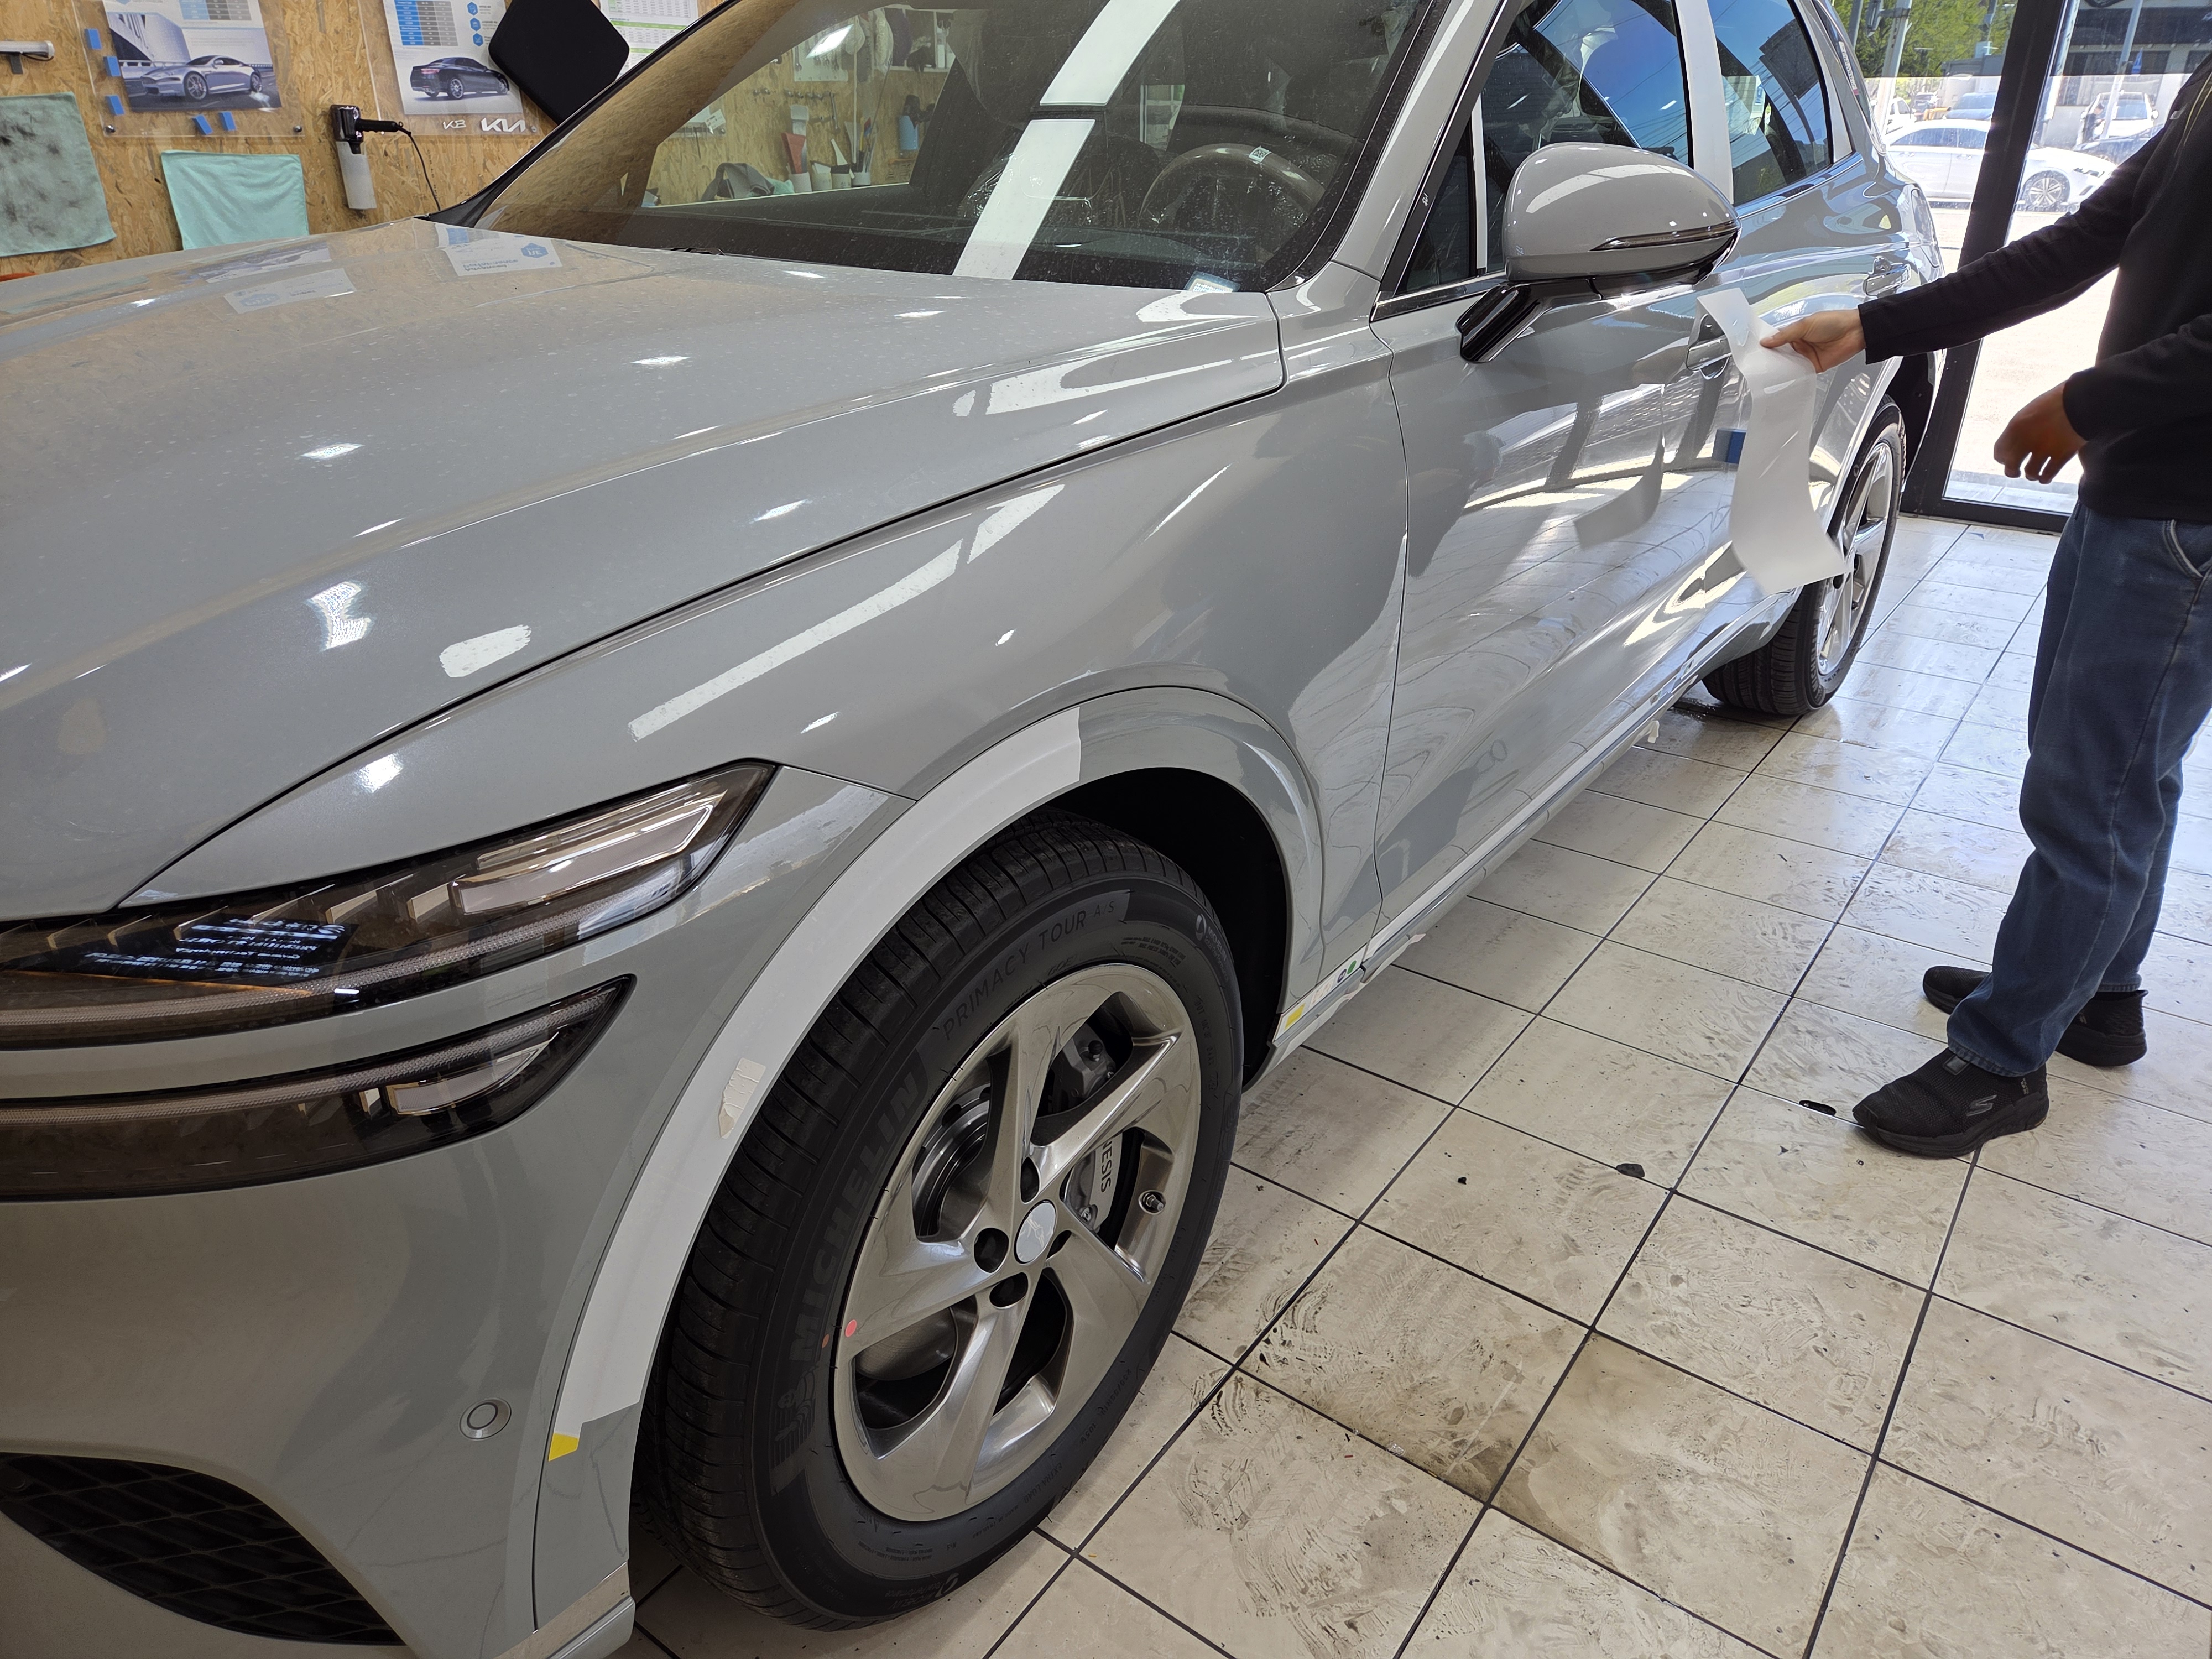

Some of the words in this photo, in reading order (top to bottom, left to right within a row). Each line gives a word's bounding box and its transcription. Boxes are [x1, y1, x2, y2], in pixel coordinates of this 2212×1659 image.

[481, 117, 526, 132] KIA
[1207, 926, 1227, 962] MICHELIN
[944, 945, 1030, 1040] PRIMACY
[1038, 910, 1087, 950] TOUR
[1093, 901, 1115, 918] A/S
[790, 1072, 919, 1362] MICHELIN
[1041, 1462, 1063, 1486] EXTRA
[1023, 1484, 1042, 1504] LOAD
